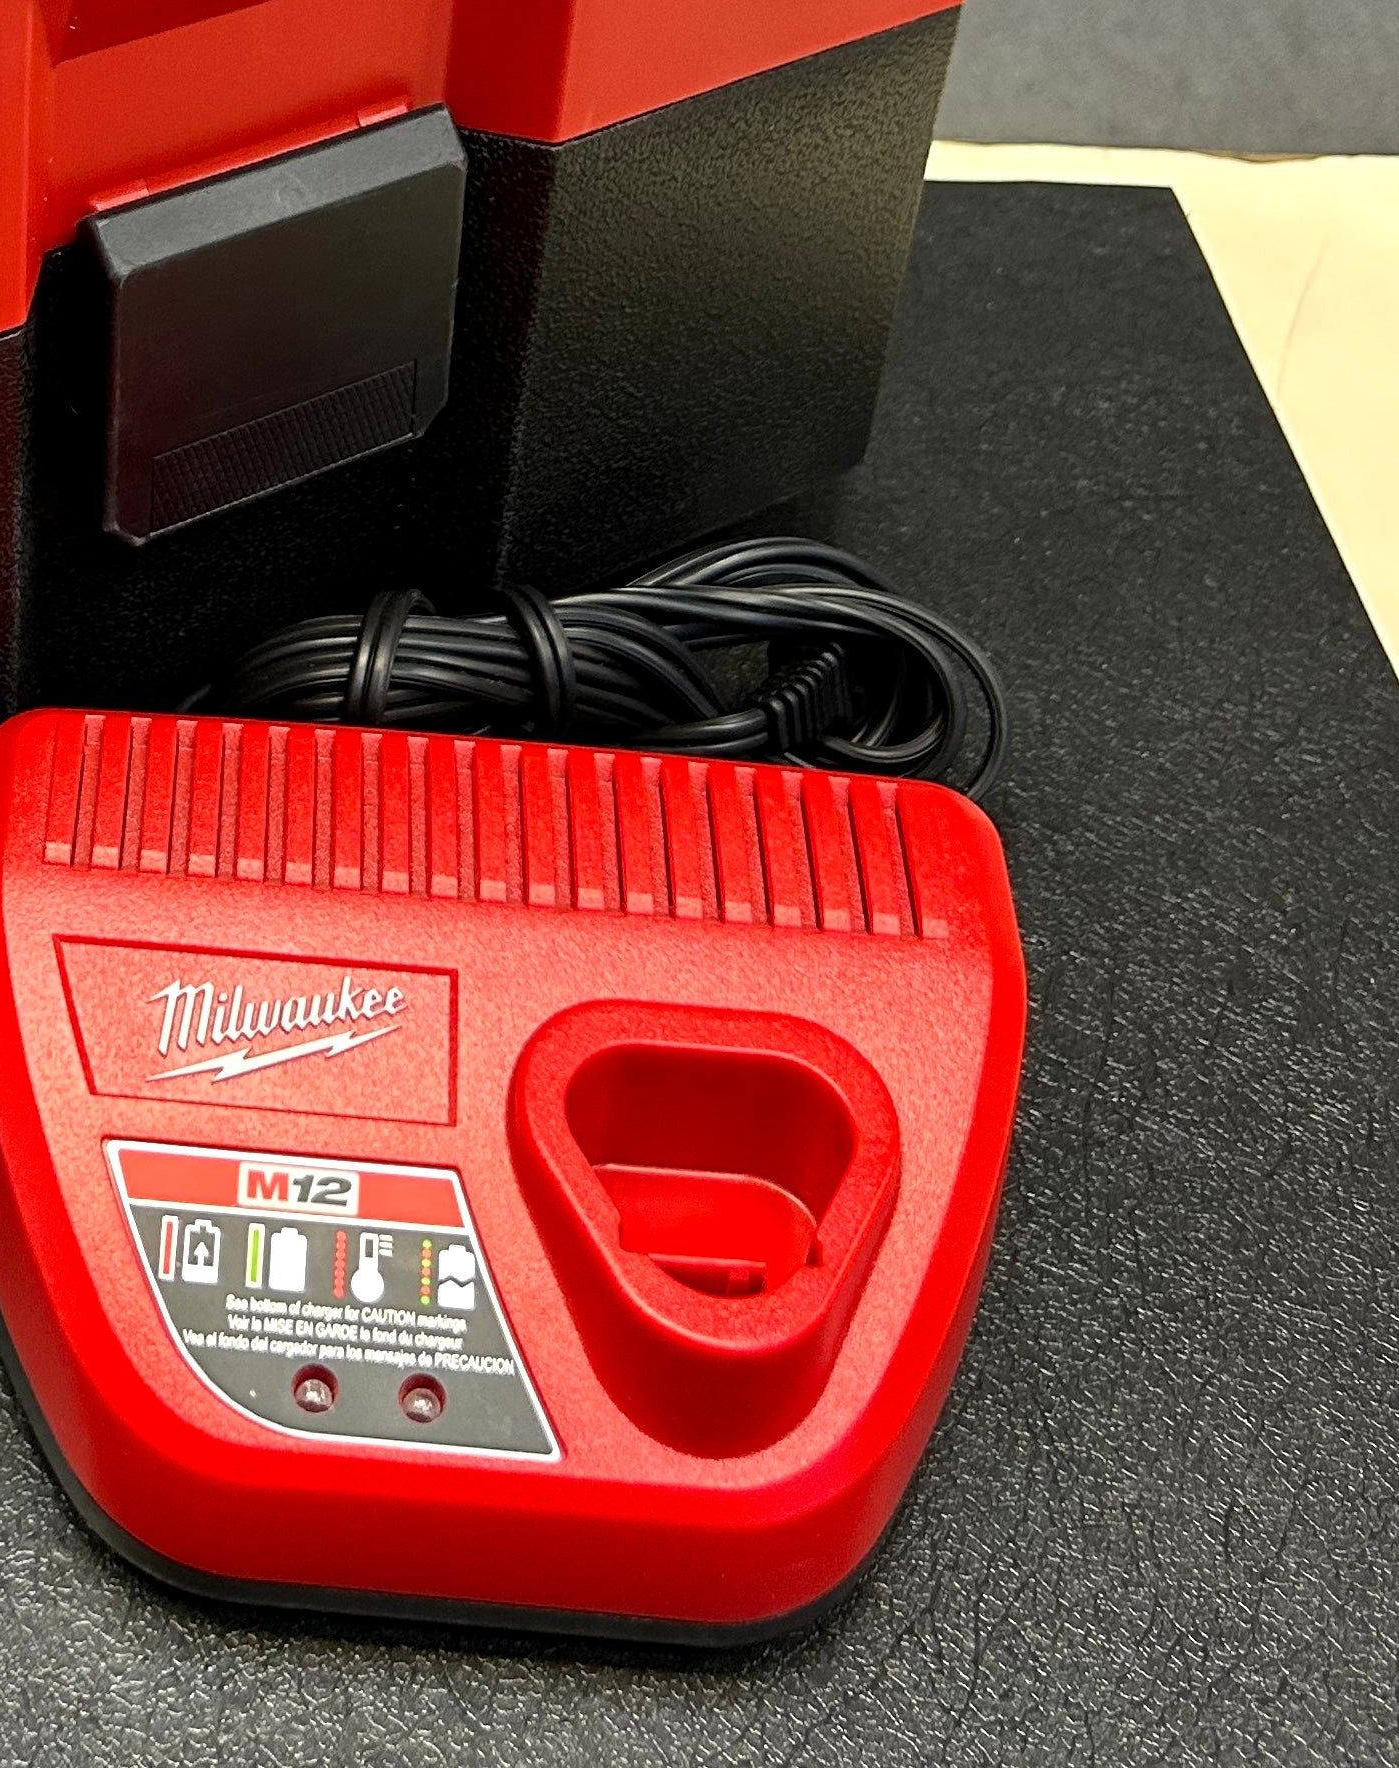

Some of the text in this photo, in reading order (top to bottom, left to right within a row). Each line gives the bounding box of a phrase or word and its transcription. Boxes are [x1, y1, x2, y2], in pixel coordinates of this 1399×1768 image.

[146, 975, 408, 1056] Milwaukee
[246, 1168, 353, 1206] M12
[225, 1293, 467, 1334] See bottom of charger for CAUTION markings
[227, 1313, 251, 1331] Voir
[263, 1316, 295, 1336] MISE
[295, 1319, 314, 1337] EN
[315, 1321, 359, 1342] GARDE
[372, 1327, 397, 1345] fond
[398, 1329, 413, 1346] du
[414, 1331, 464, 1352] chargeur
[182, 1328, 205, 1347] Vea
[218, 1331, 250, 1350] fondo
[250, 1335, 269, 1352] del
[269, 1339, 318, 1358] cargador
[318, 1344, 345, 1360] para
[345, 1344, 363, 1361] los
[363, 1348, 417, 1369] mensajes
[434, 1351, 516, 1376] PRECAUCION
